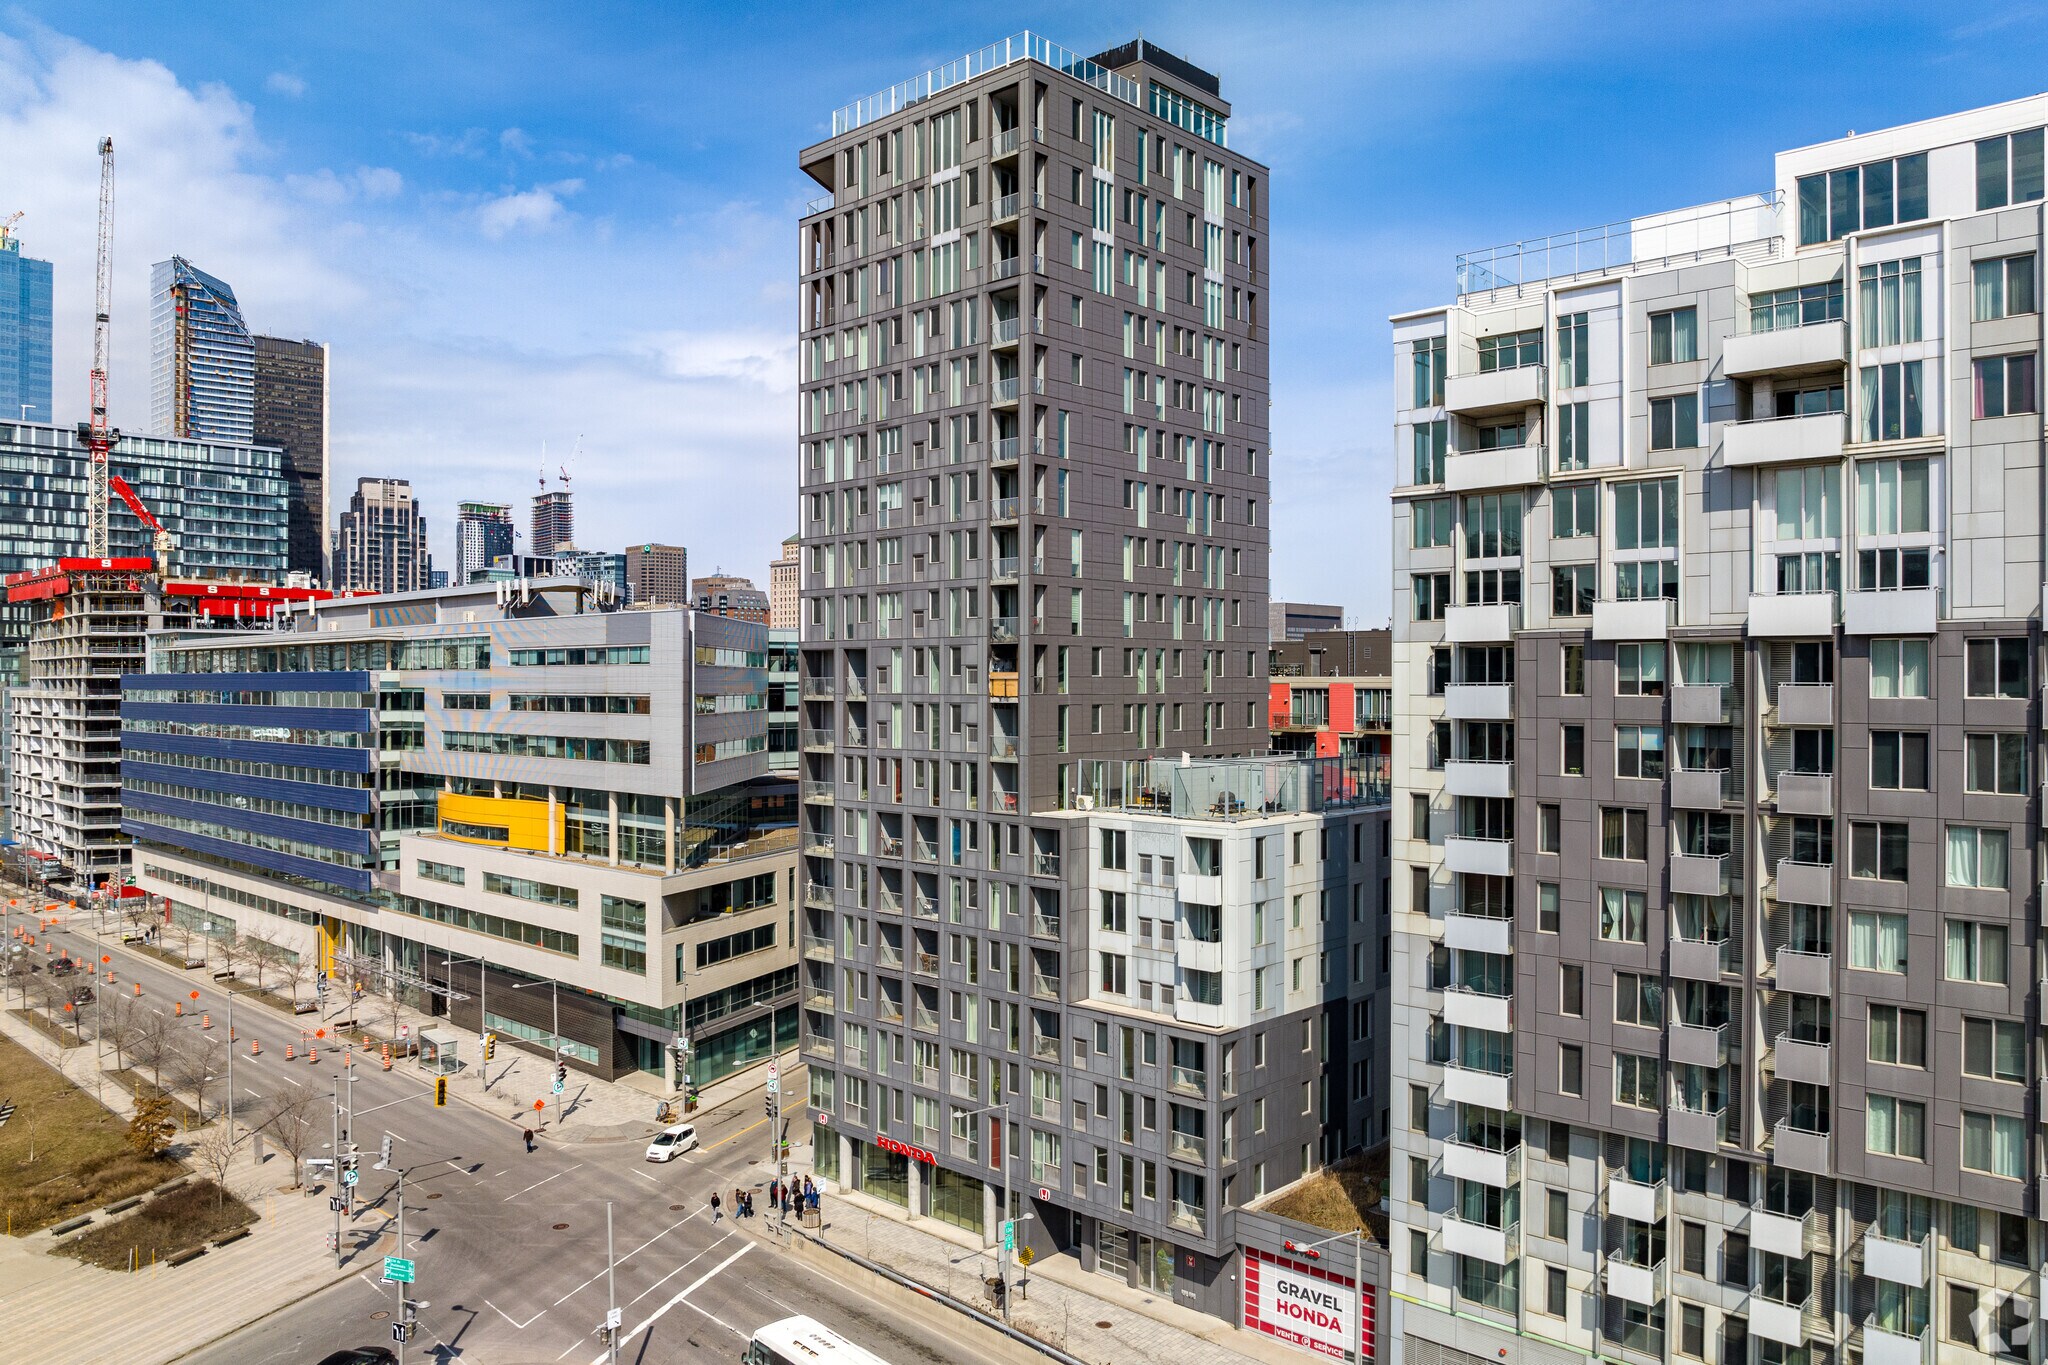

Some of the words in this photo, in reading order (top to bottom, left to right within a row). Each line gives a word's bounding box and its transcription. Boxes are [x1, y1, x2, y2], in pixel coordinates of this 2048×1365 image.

[876, 1135, 938, 1166] HONDA
[1277, 1280, 1343, 1312] GRAVEL
[1276, 1298, 1343, 1333] HONDA
[1276, 1328, 1299, 1343] VENTE
[1313, 1341, 1344, 1358] SERVICE
